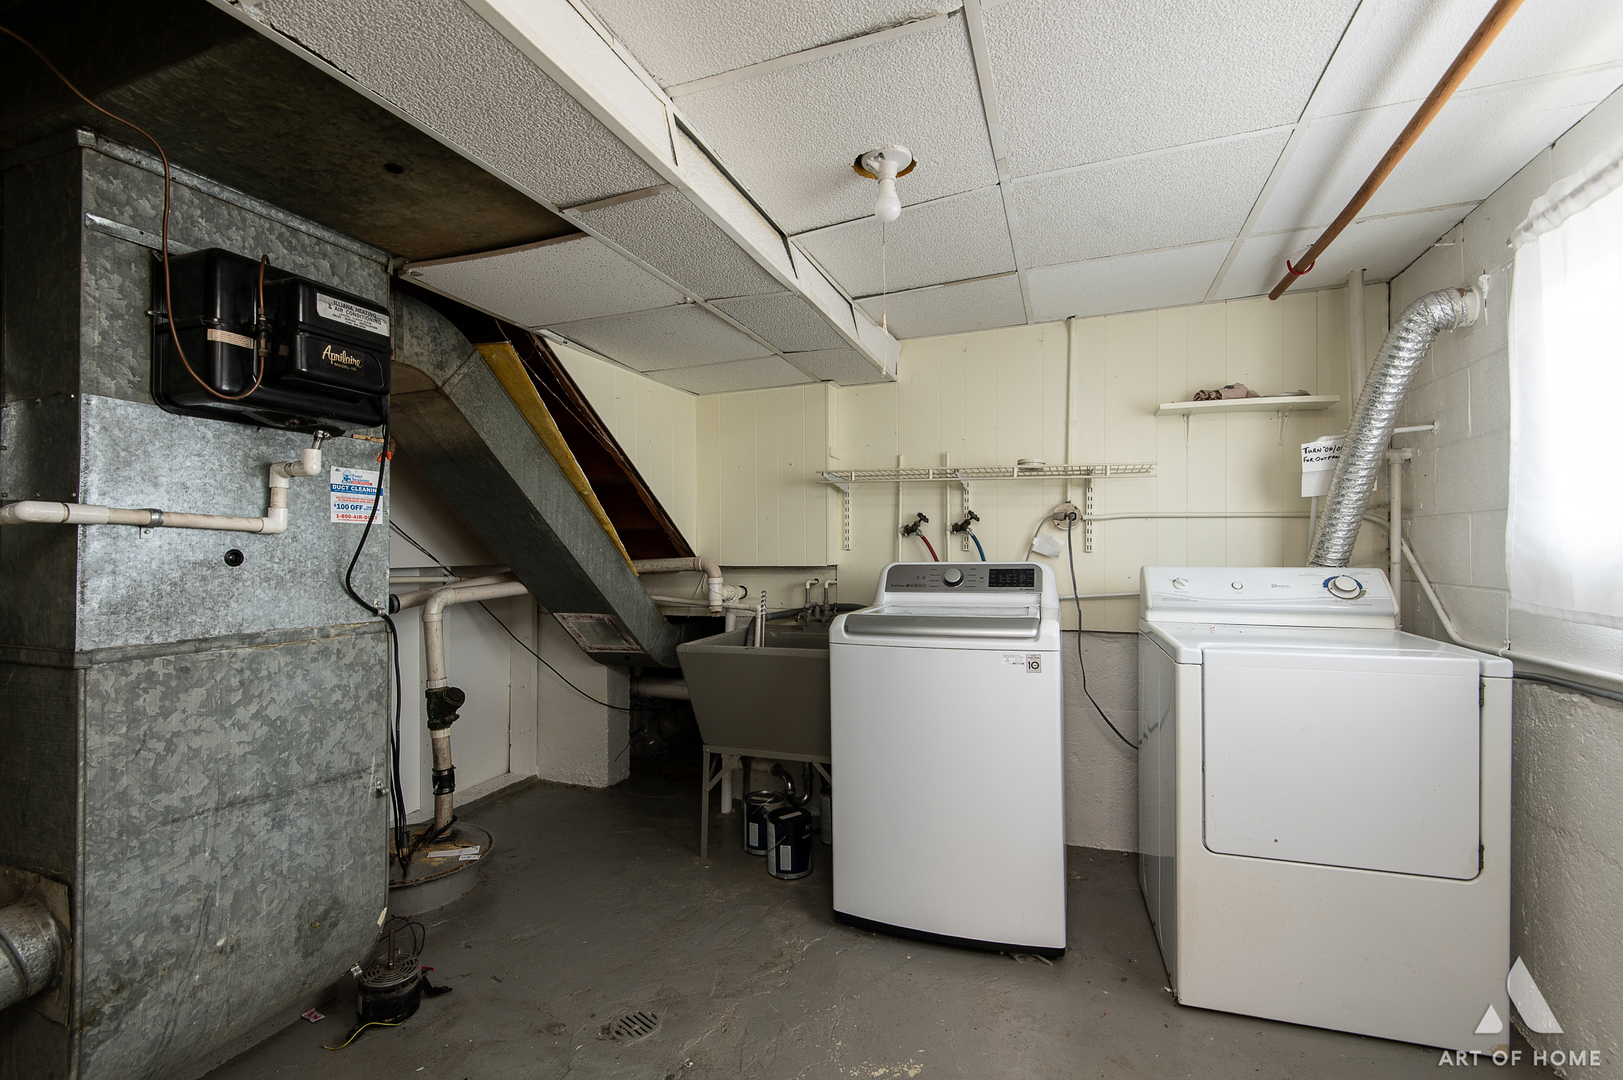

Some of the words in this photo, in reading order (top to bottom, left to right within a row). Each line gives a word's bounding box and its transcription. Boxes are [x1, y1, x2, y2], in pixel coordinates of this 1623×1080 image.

[333, 300, 353, 310] ILLIANA
[355, 306, 377, 318] HEATING
[345, 309, 382, 325] CONDITIONING
[322, 345, 363, 368] Aprilaire
[350, 485, 377, 493] CLEANIN
